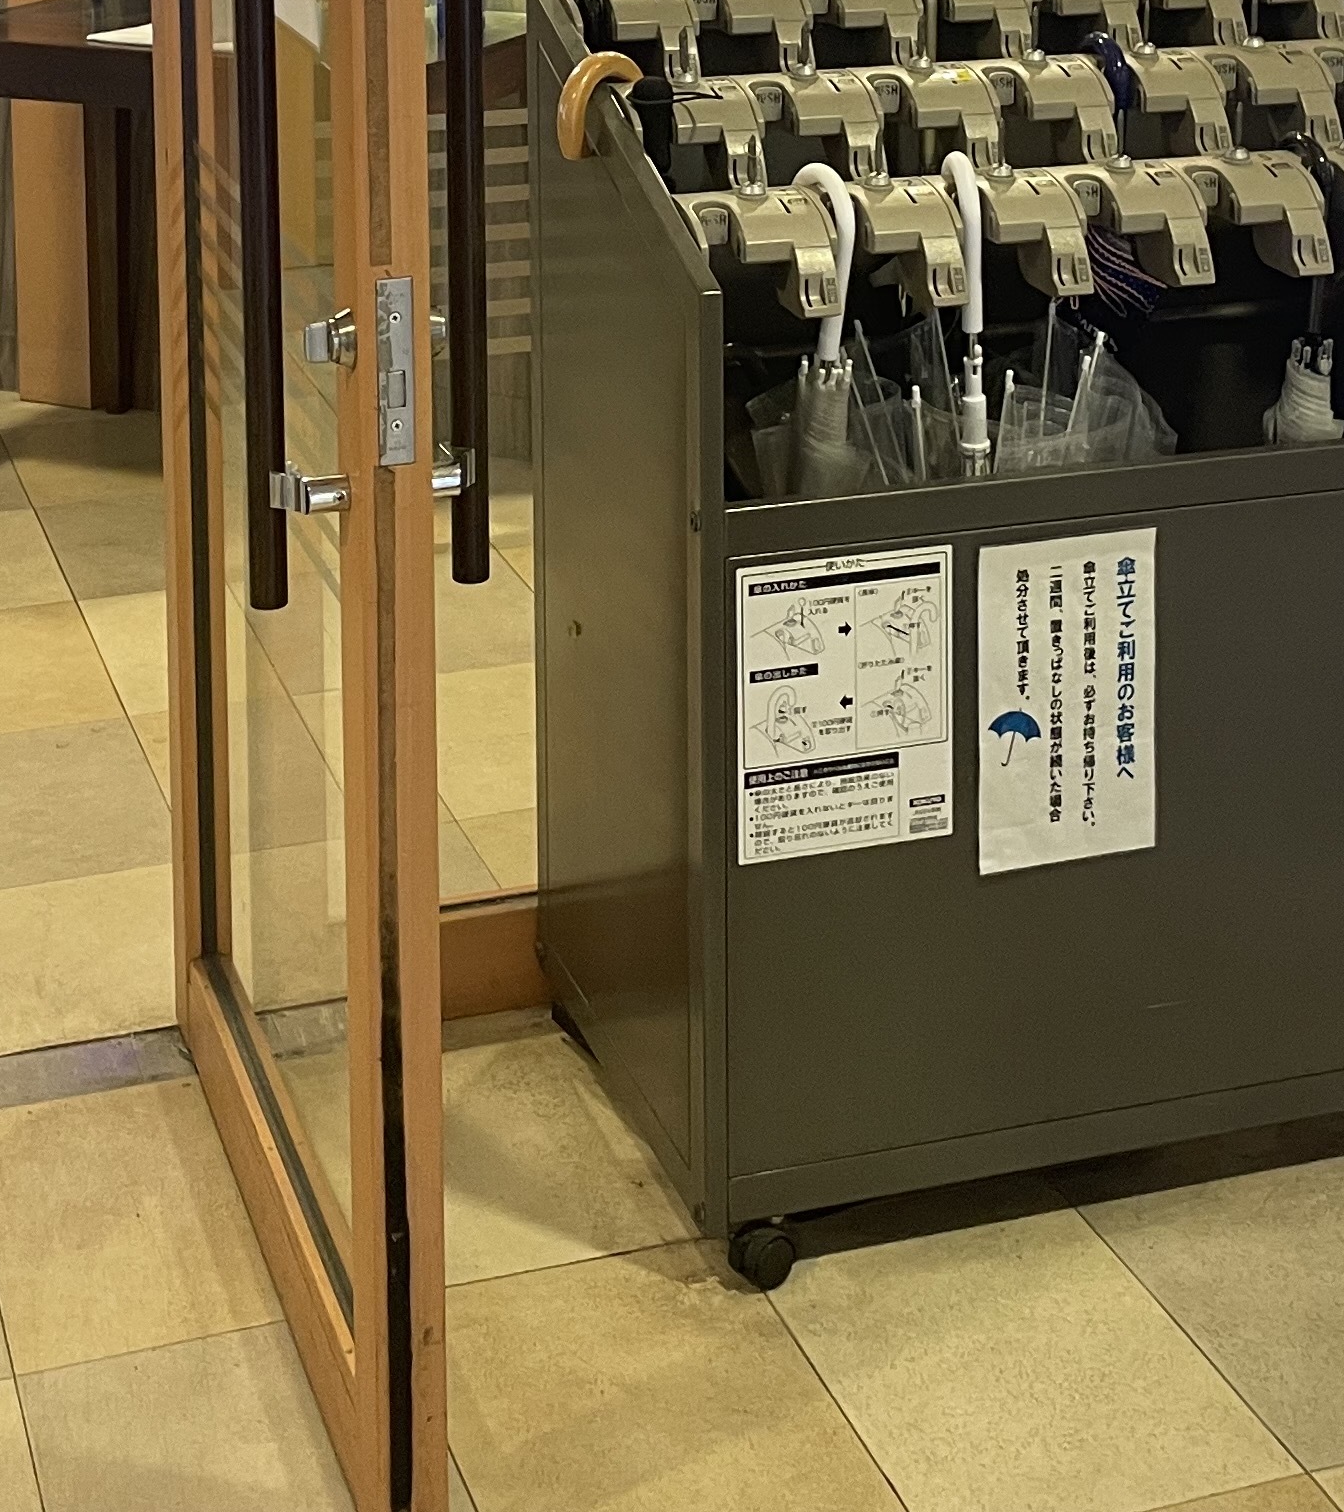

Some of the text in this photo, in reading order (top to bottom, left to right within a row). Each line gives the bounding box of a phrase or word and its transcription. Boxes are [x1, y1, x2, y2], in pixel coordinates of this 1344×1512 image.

[1016, 568, 1031, 701] 処分させて頂きます。
[1116, 556, 1137, 780] 傘立てご利用のお客様へ
